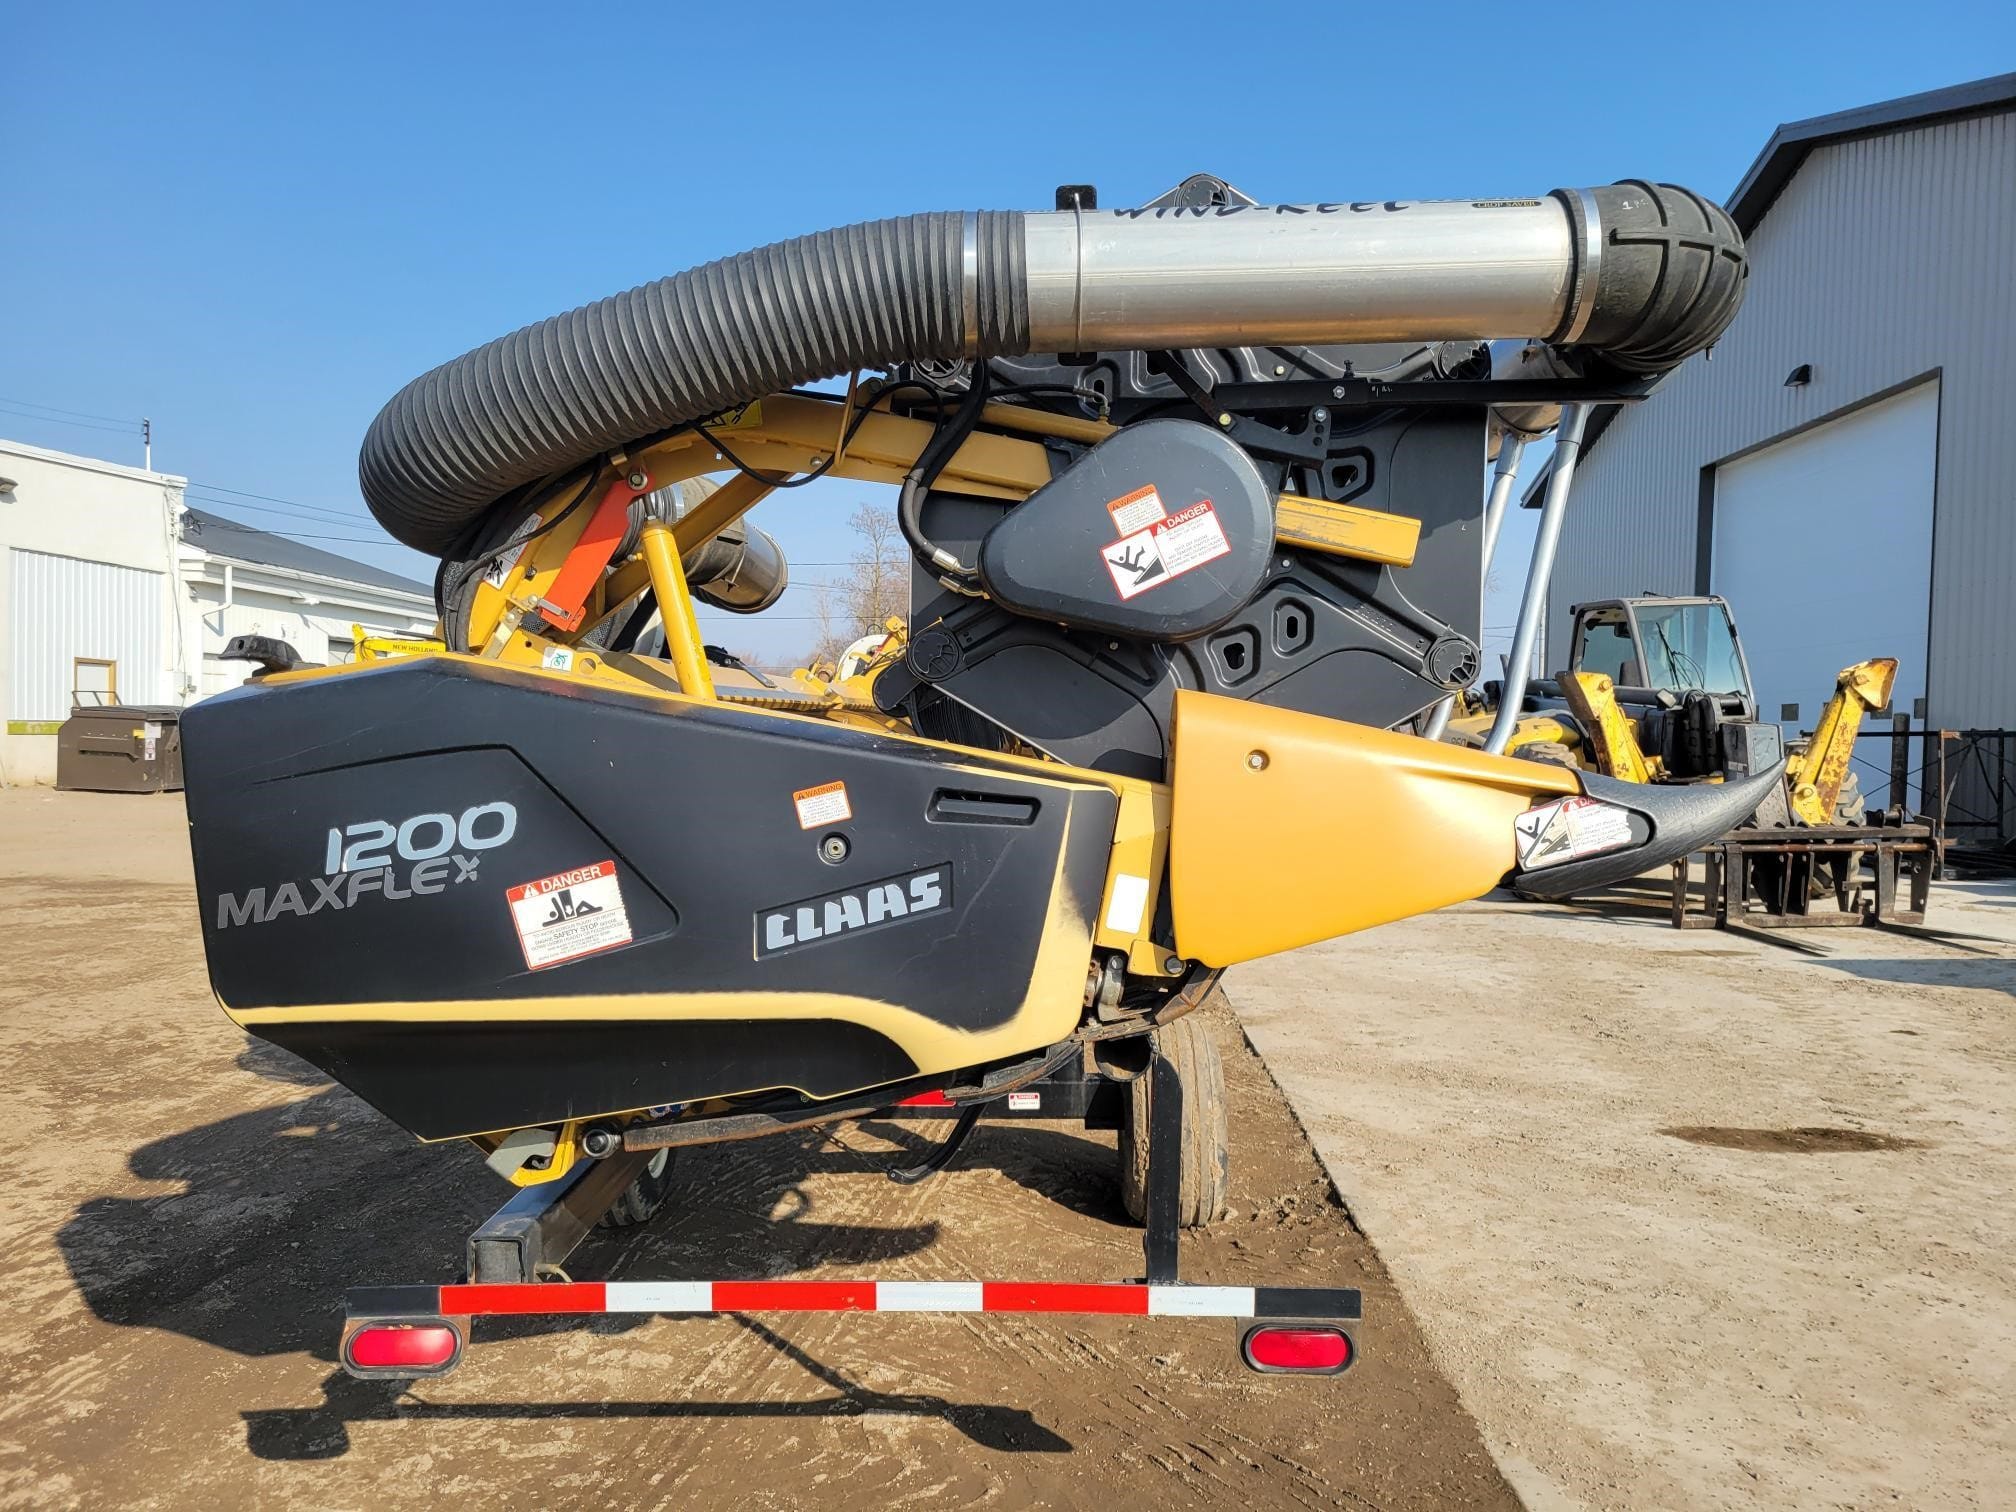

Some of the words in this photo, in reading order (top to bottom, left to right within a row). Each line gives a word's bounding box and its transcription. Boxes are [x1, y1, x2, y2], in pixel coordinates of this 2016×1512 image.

[1167, 503, 1209, 528] DANGER
[805, 784, 842, 797] WARNING
[326, 802, 517, 875] 1200
[217, 853, 482, 929] MAXFLEX
[541, 866, 602, 893] DANGER
[766, 872, 942, 950] CLAAS
[553, 928, 578, 939] SAFETY
[580, 922, 598, 931] STOP
